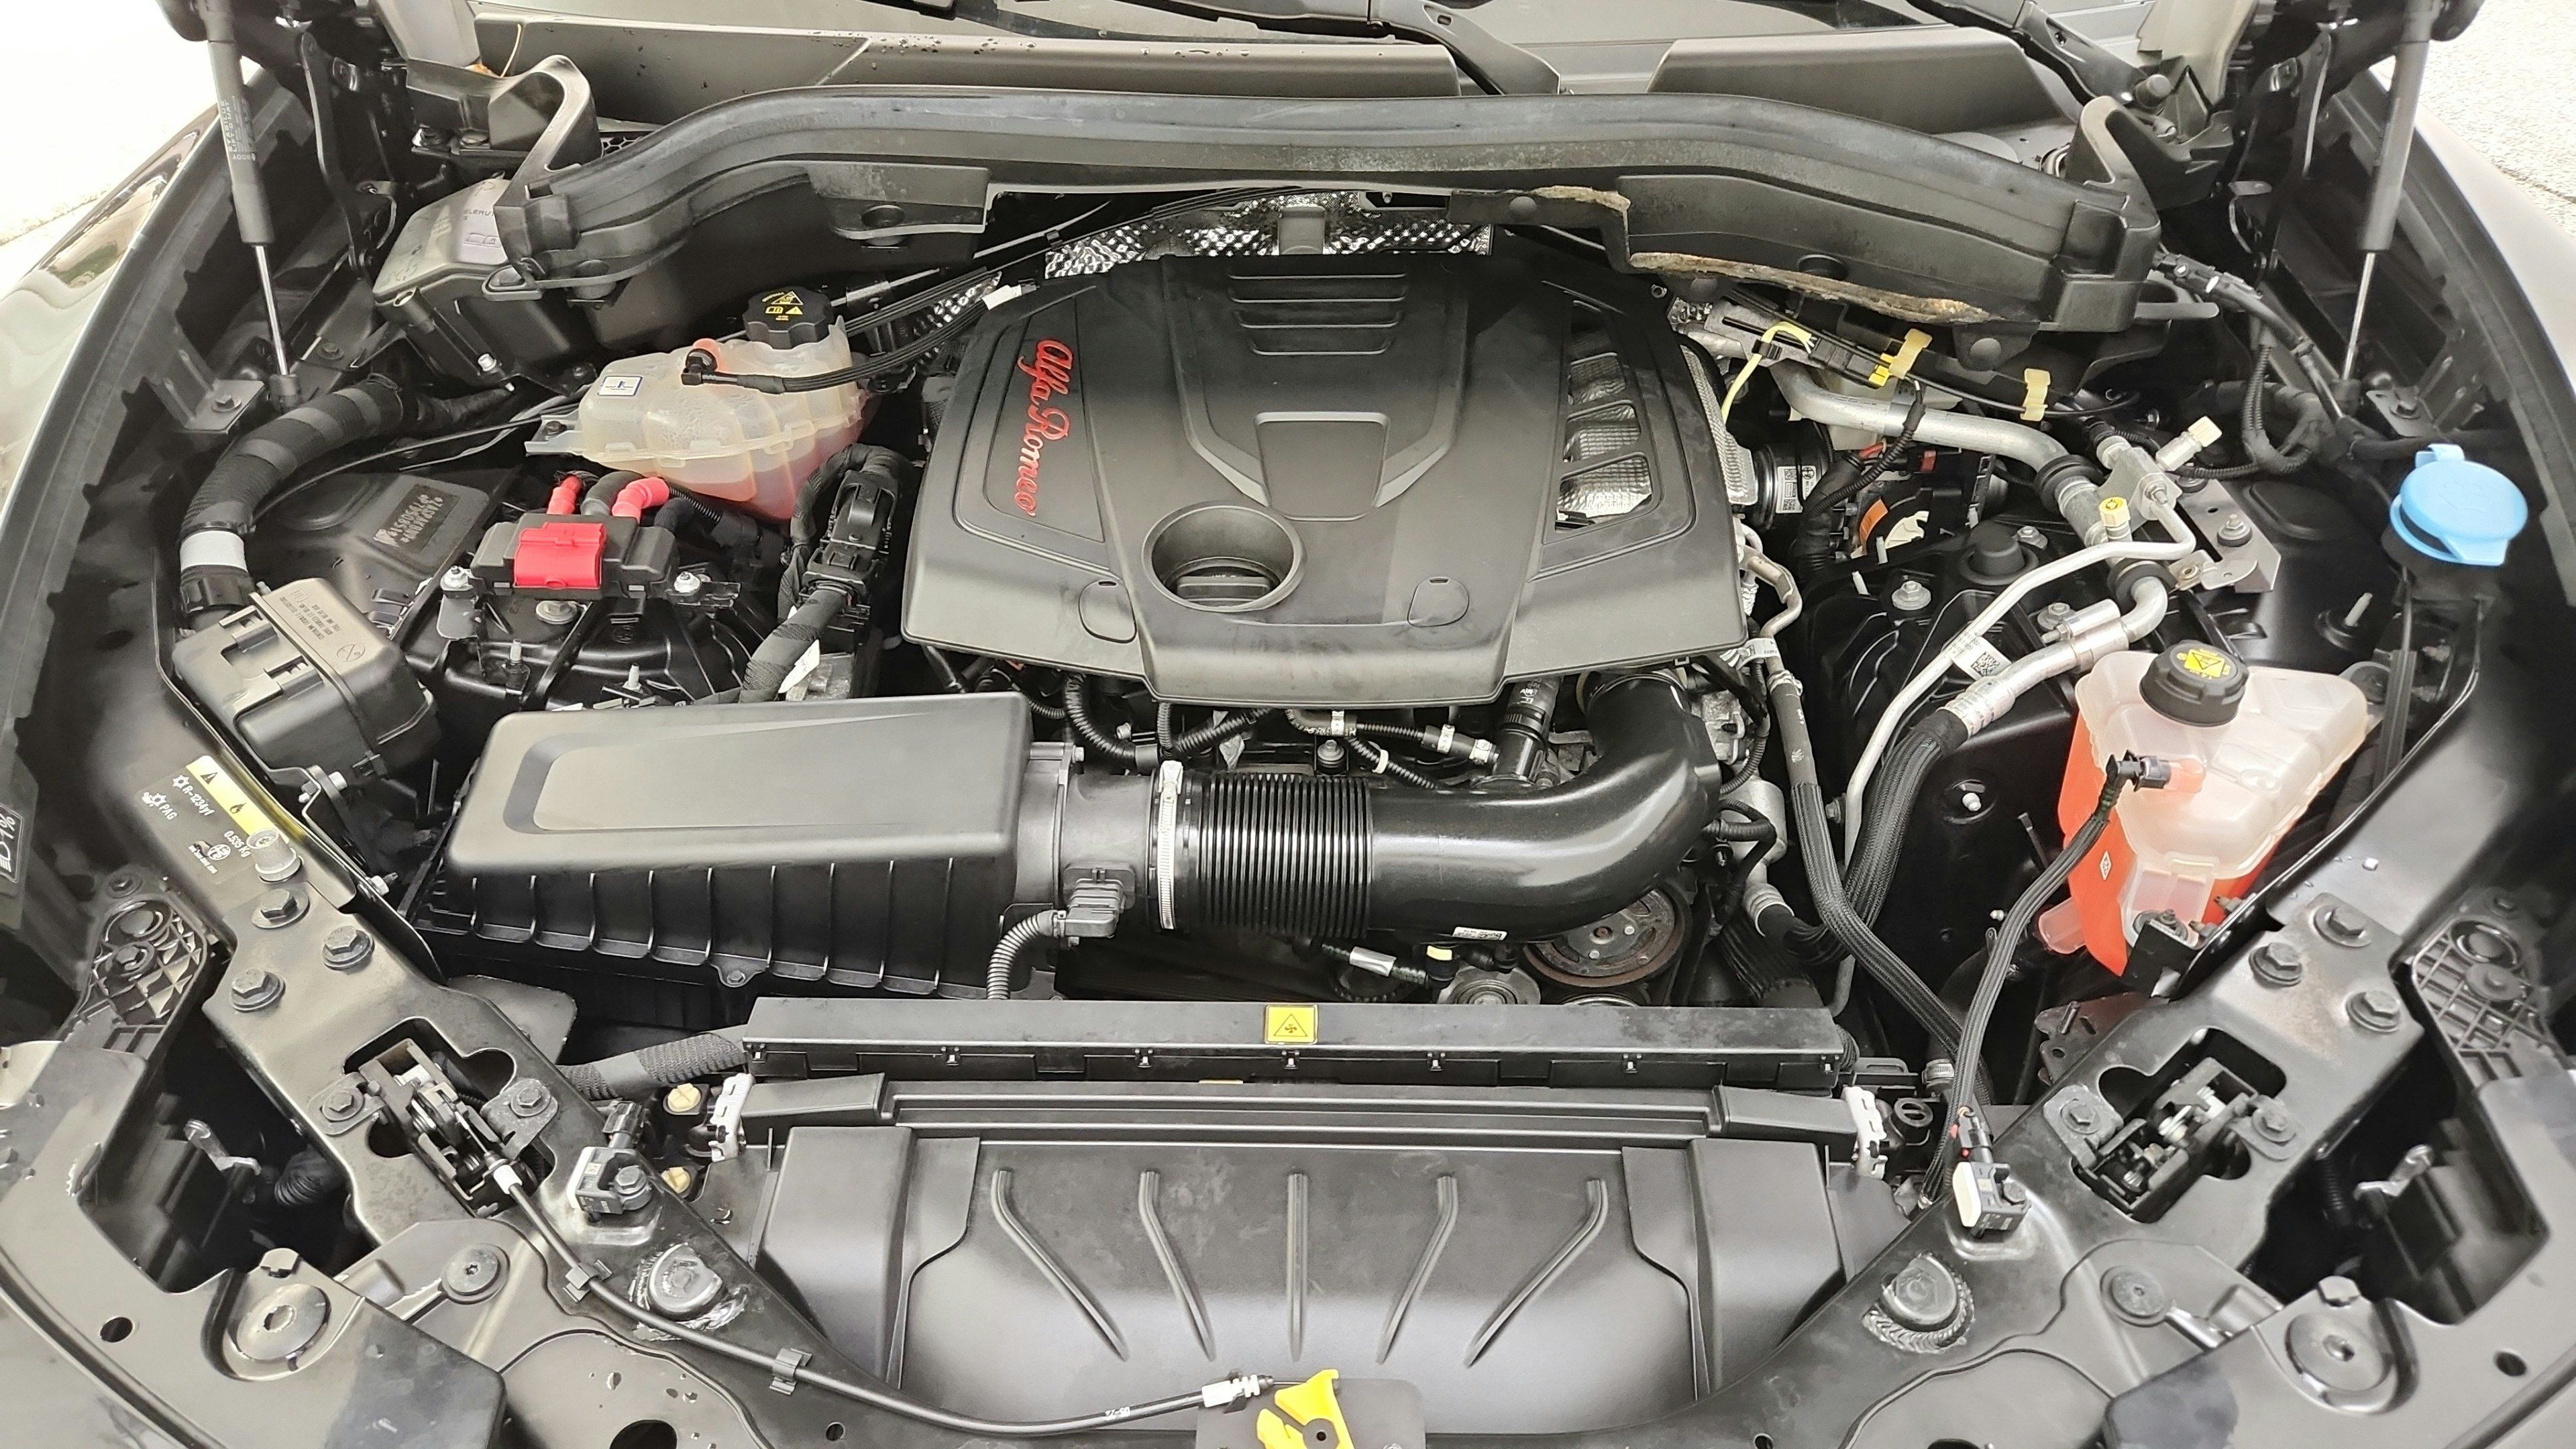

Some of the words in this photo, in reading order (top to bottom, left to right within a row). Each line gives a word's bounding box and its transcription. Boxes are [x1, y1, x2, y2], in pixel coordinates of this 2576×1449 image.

[1014, 404, 1070, 517] Romeo
[158, 804, 178, 820] PAG
[182, 785, 215, 816] R-1234yf
[223, 830, 245, 849] 0.535
